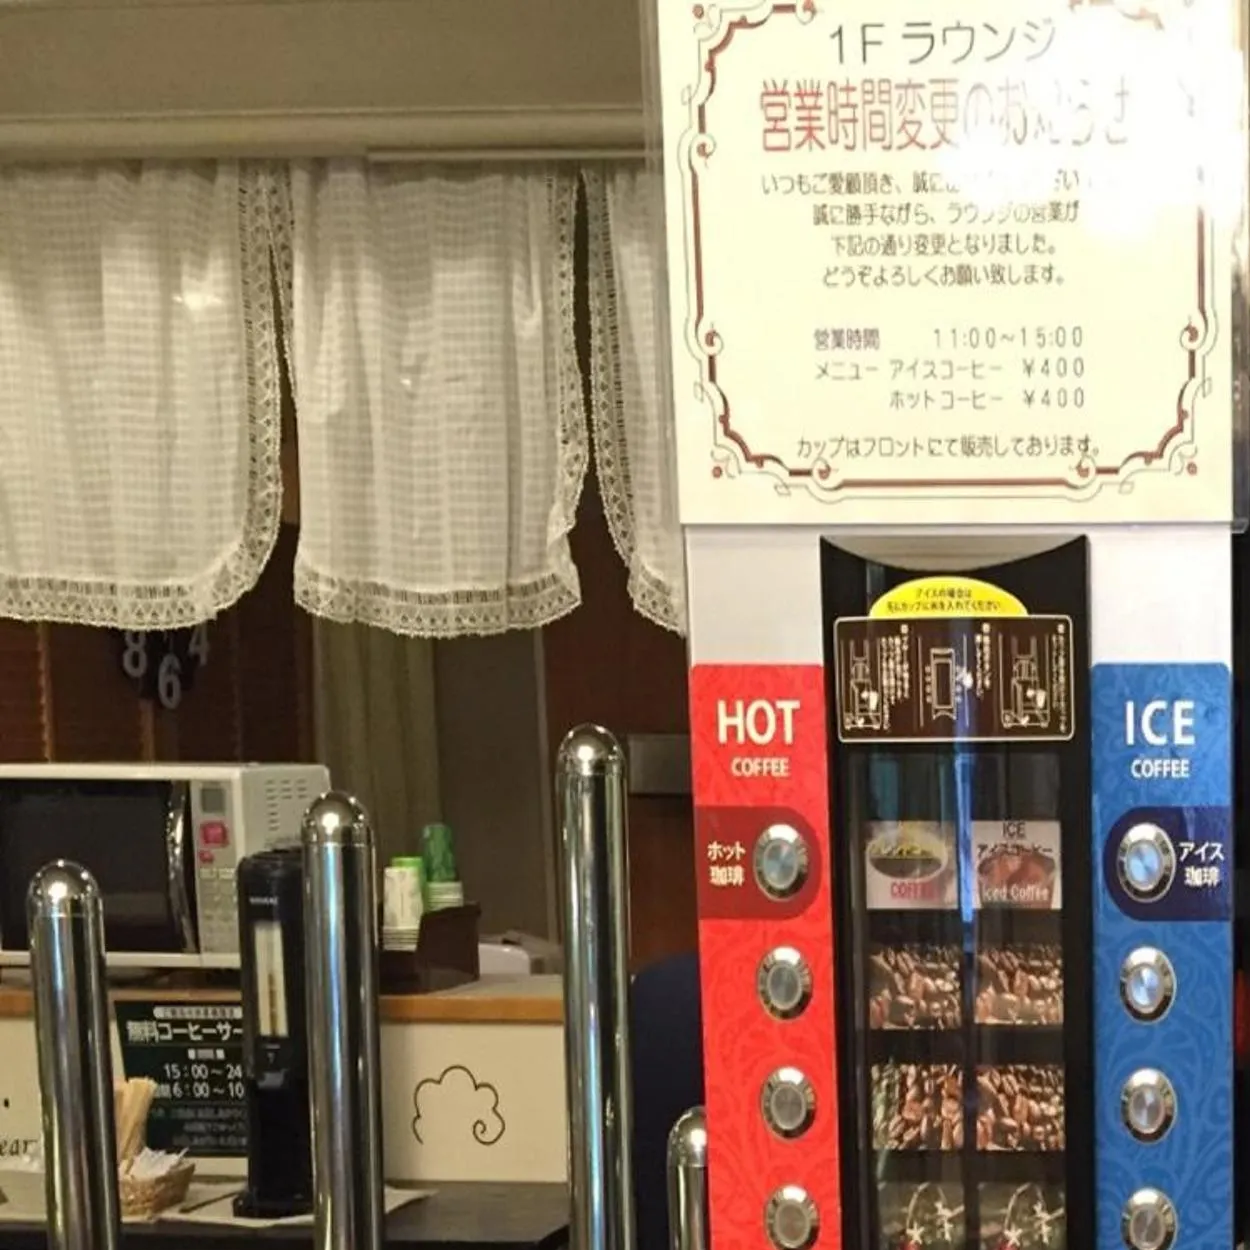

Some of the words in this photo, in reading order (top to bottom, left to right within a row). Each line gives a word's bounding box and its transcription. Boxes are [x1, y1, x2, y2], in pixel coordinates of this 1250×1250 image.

[831, 233, 1056, 257] 下記の通り変更となりました。
[823, 263, 1065, 288] どうぞよろしくお願い致します。
[813, 327, 880, 351] 営業時間
[814, 359, 878, 381] メニュー
[889, 358, 1003, 381] アイスコーヒー
[889, 389, 1003, 411] ホットコーヒー
[797, 434, 1100, 459] カップはフロントにて販売しております。
[717, 699, 800, 745] HOT
[1124, 699, 1196, 746] ICE
[731, 756, 790, 778] COFFEE
[1130, 758, 1191, 779] COFFEE
[1003, 821, 1026, 838] ICE
[706, 840, 747, 862] ホット
[1178, 841, 1226, 863] アイス
[709, 865, 746, 887] 珈琲
[1183, 865, 1221, 888] 珈琲
[1010, 884, 1050, 899] Coffee
